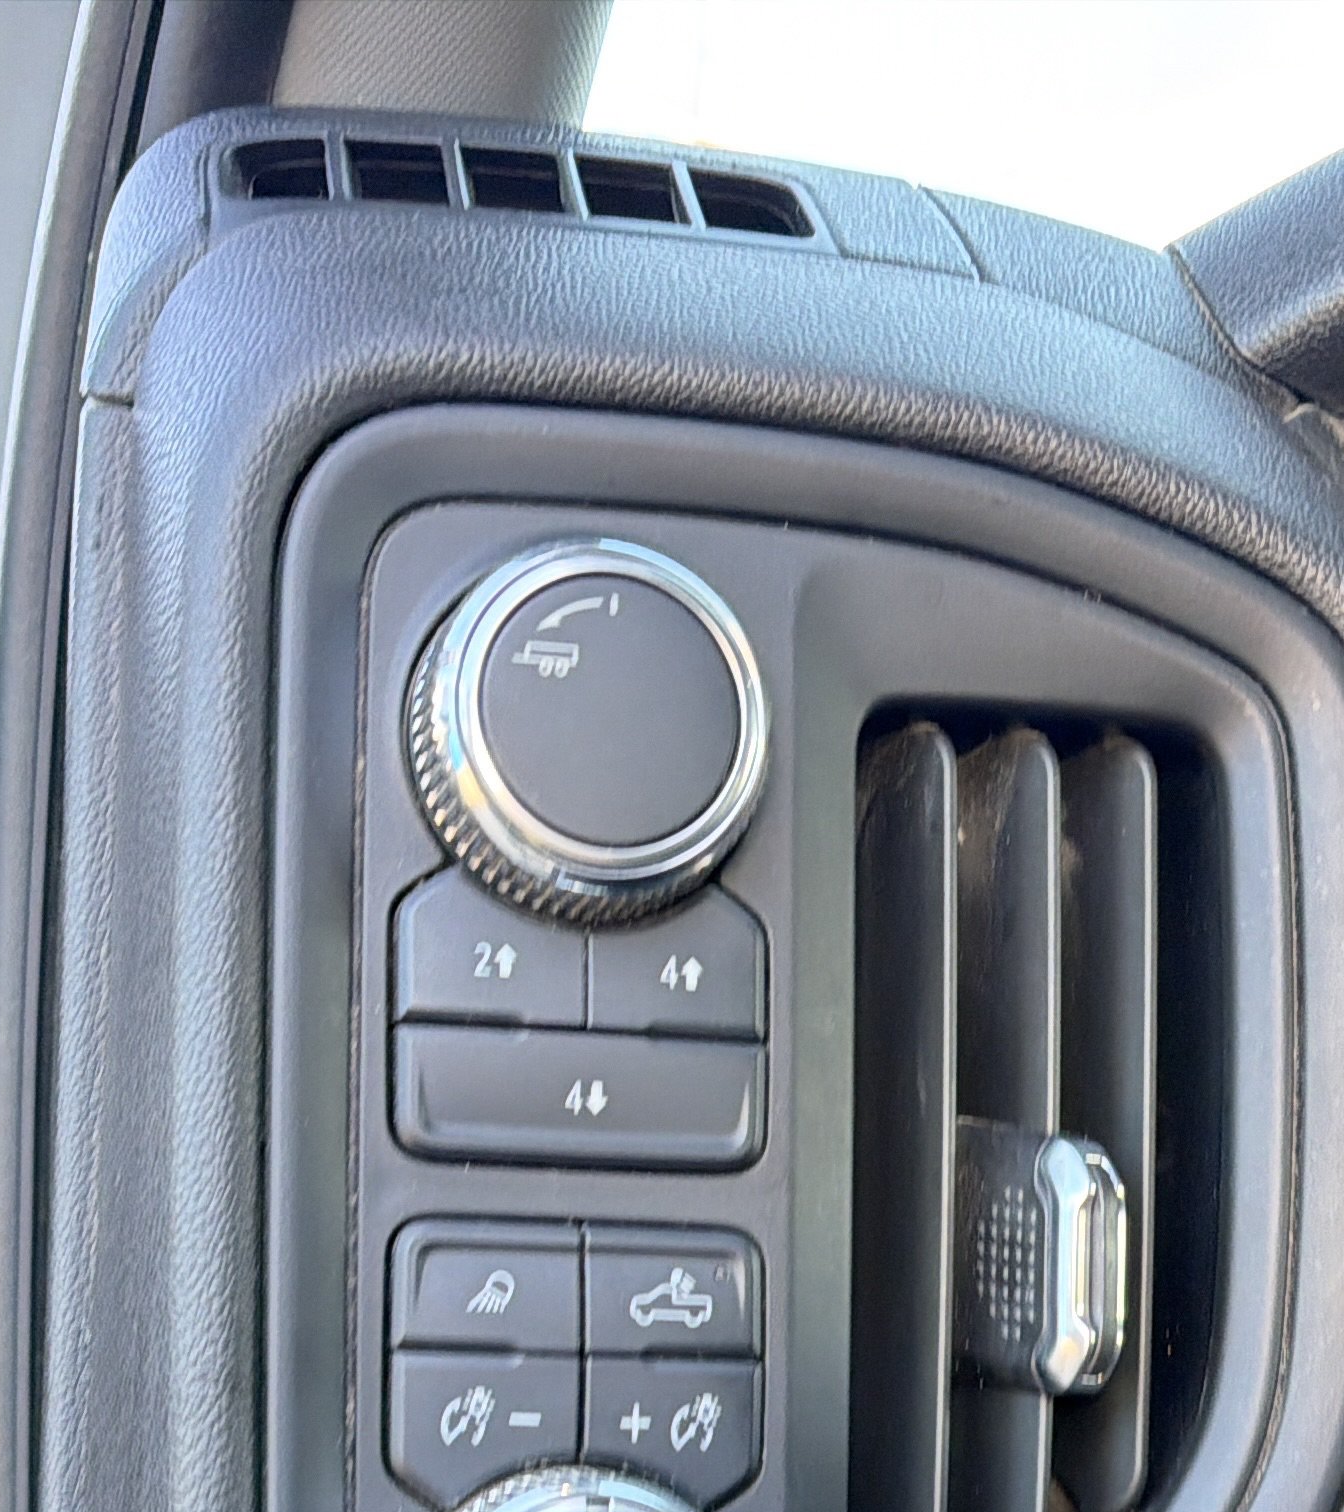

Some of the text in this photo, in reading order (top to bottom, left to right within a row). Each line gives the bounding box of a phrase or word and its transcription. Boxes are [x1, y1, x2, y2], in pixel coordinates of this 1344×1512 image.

[473, 940, 493, 979] 2
[659, 953, 679, 992] 4
[564, 1078, 584, 1117] 4
